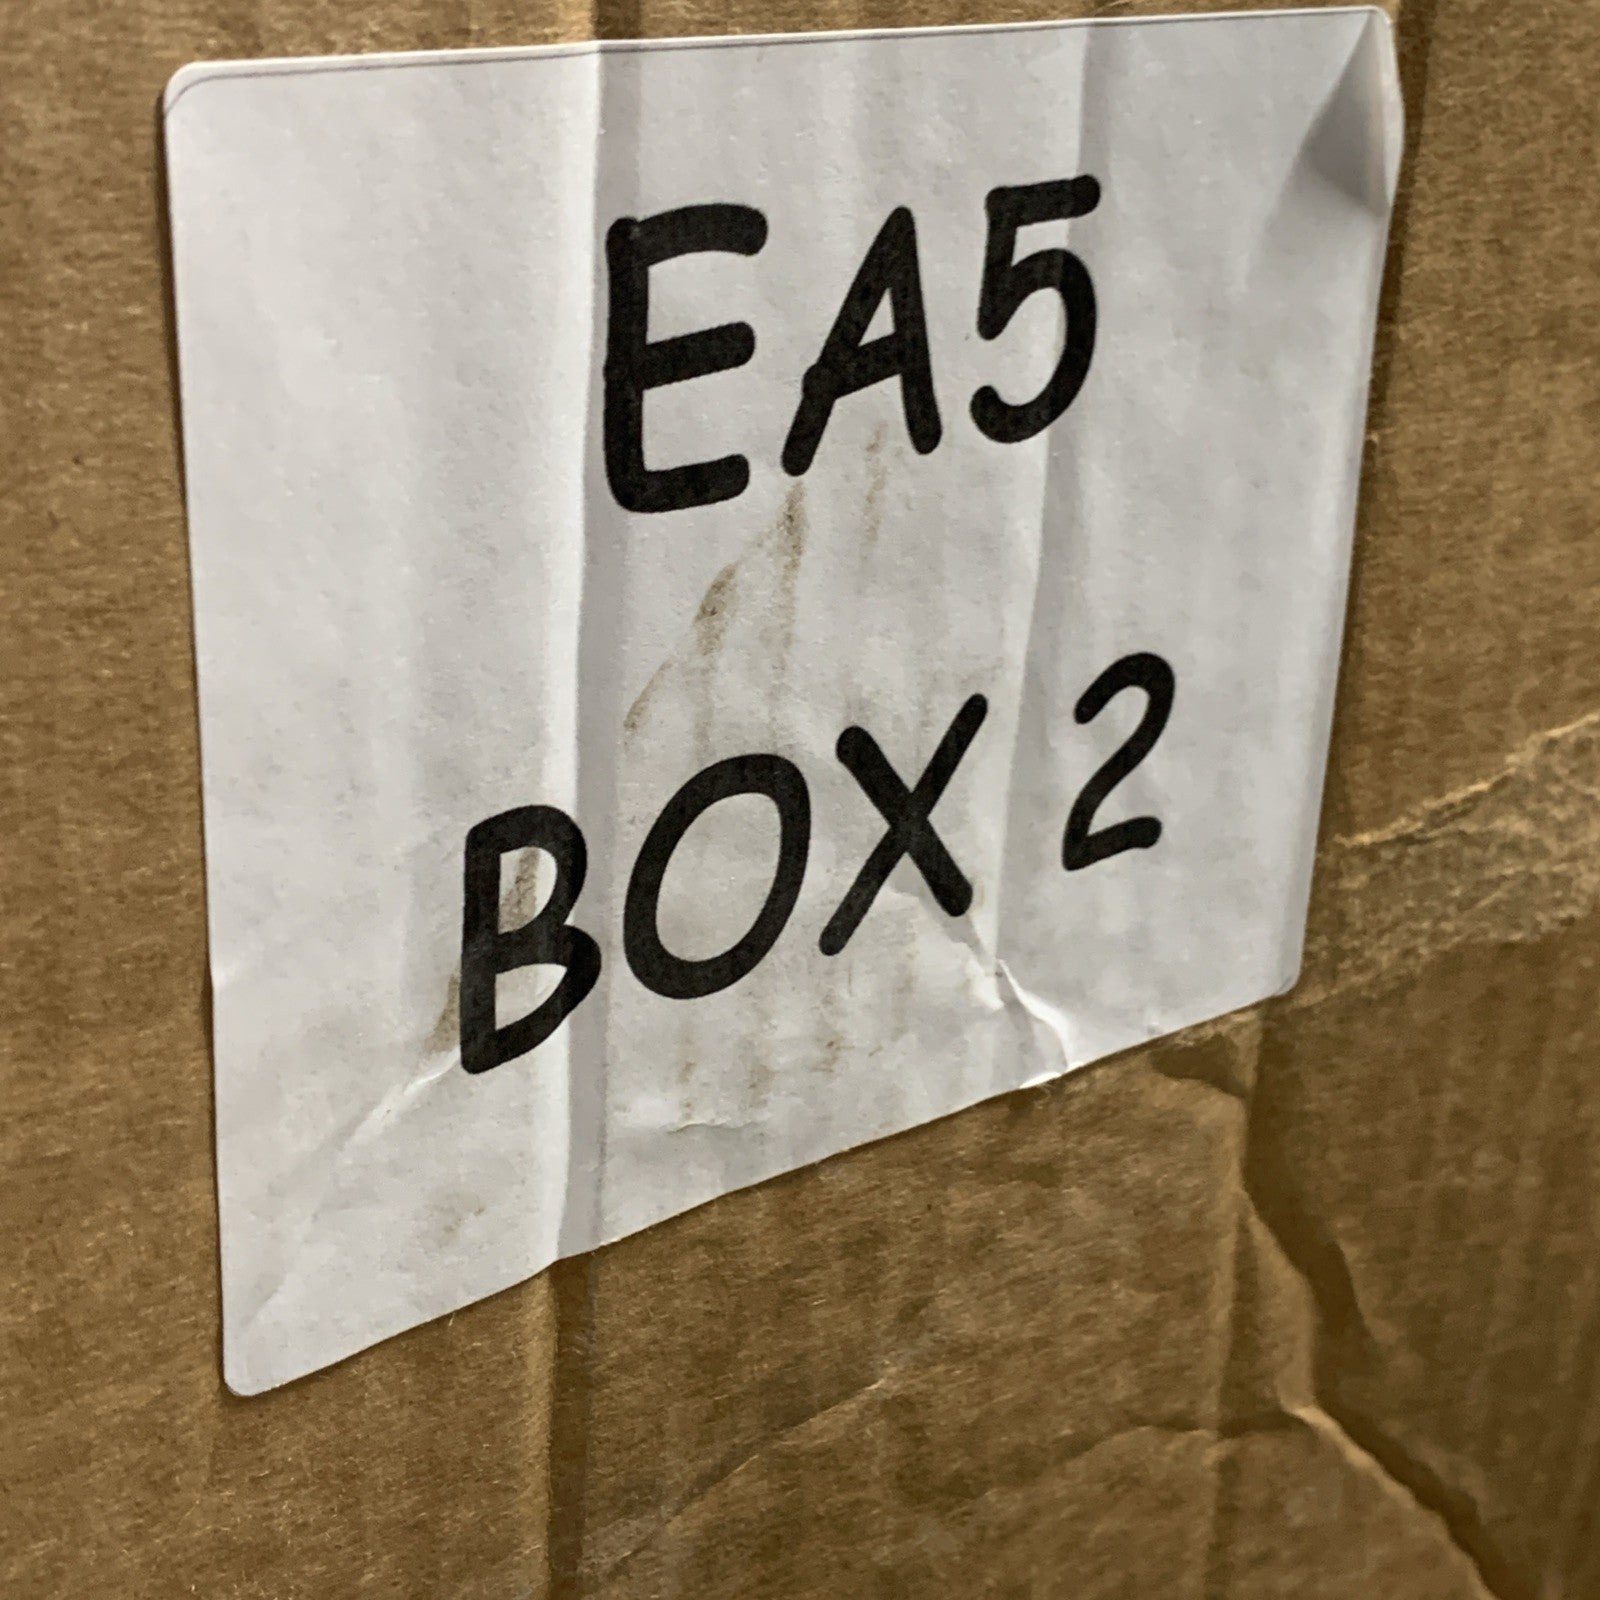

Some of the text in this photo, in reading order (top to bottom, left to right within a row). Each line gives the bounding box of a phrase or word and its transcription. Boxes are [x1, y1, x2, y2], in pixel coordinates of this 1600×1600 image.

[602, 173, 1103, 514] EA5
[458, 651, 1177, 1075] BOX 2
